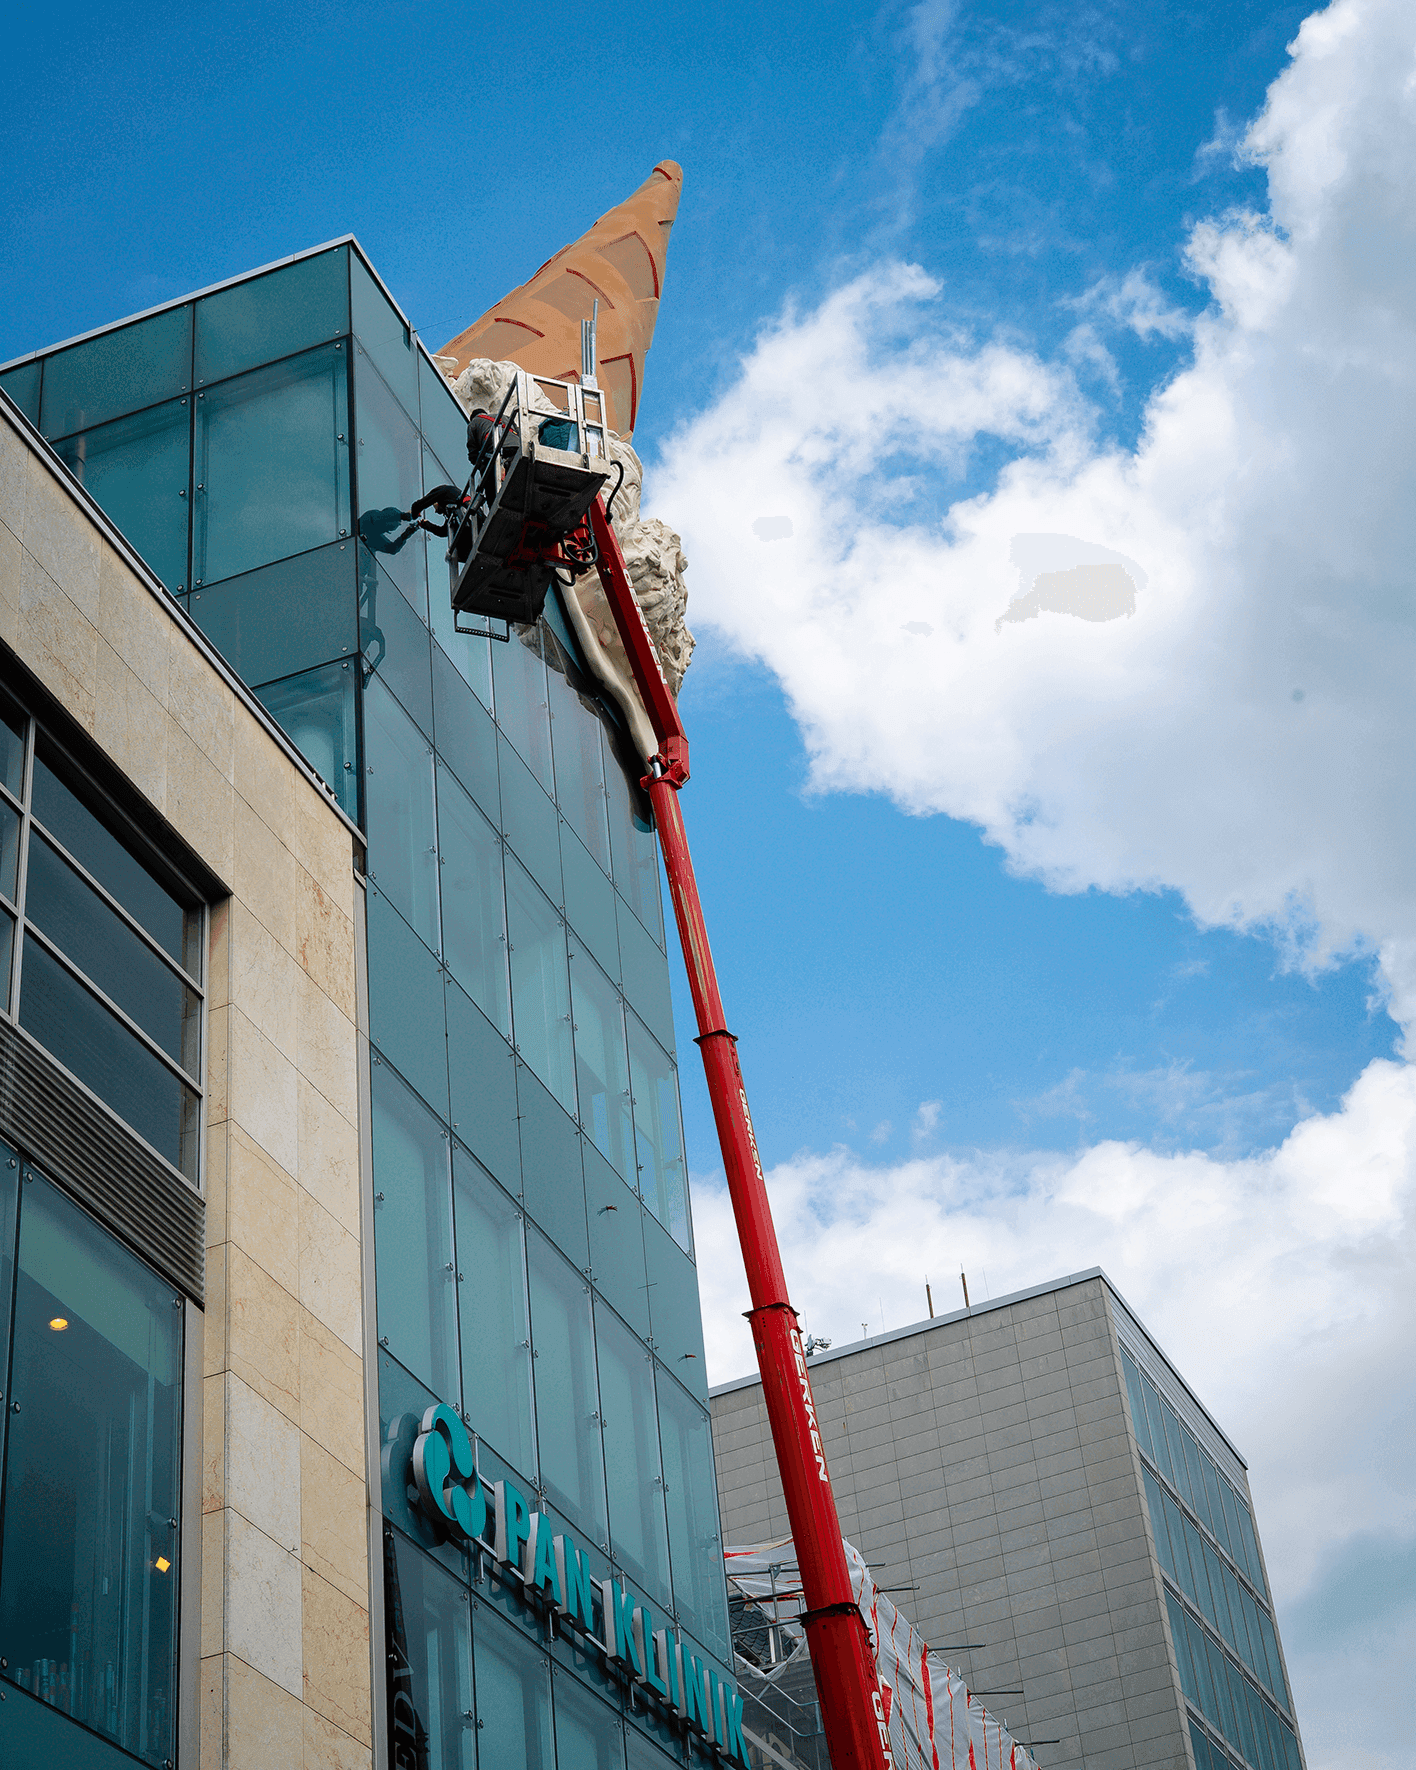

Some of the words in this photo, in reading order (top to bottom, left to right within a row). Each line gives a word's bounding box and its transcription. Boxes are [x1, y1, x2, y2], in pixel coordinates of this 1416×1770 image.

[739, 1088, 763, 1181] GERKEN
[790, 1328, 829, 1483] GERKEN
[495, 1480, 594, 1634] PAN
[602, 1578, 751, 1770] KLINIK
